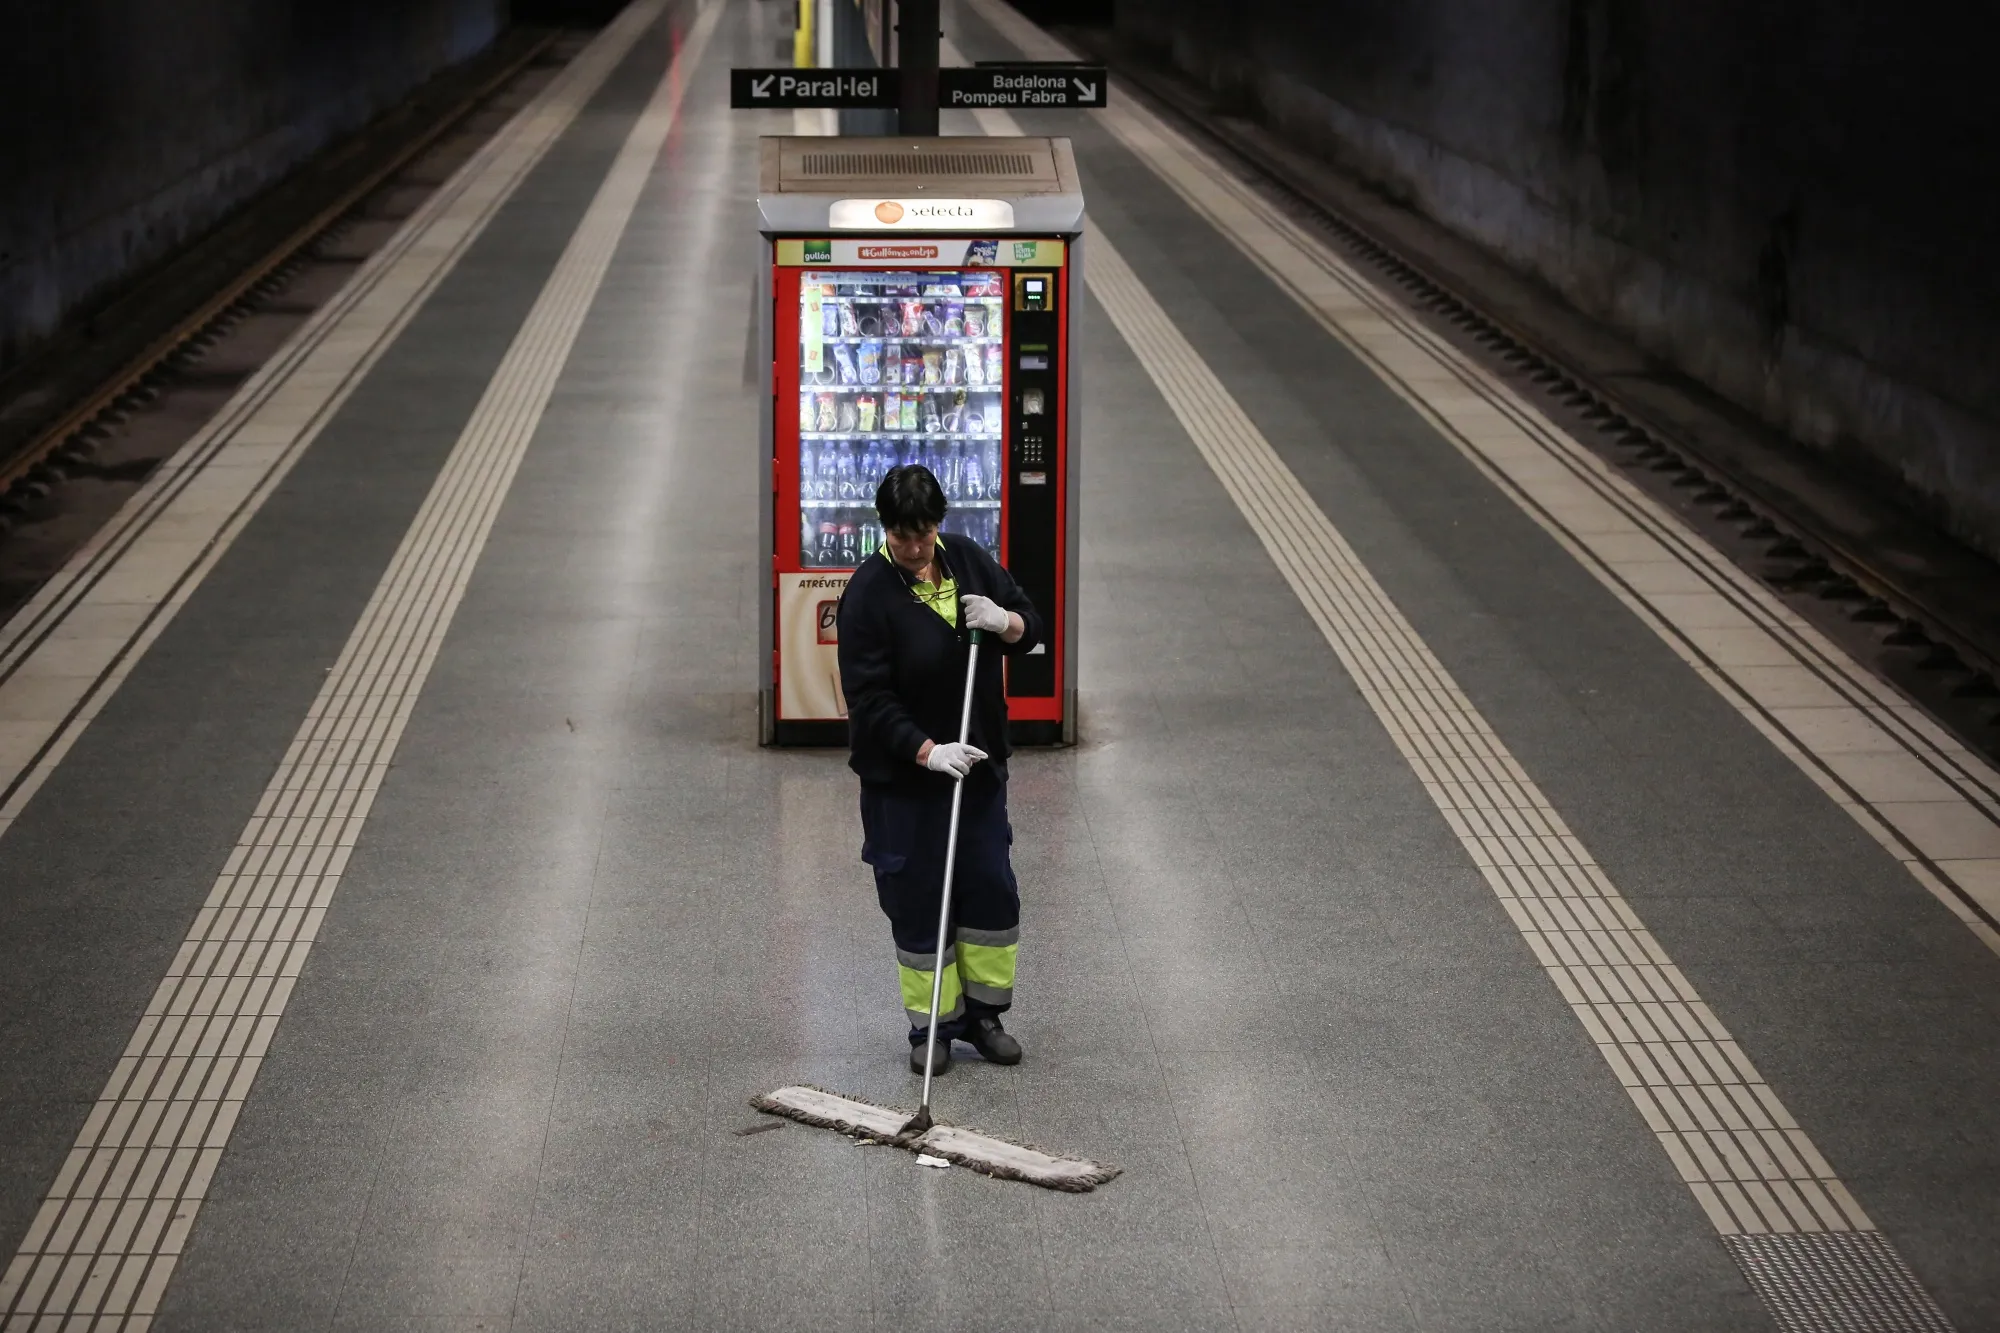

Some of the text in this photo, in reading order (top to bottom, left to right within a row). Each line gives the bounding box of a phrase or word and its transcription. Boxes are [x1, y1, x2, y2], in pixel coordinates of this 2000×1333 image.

[779, 76, 878, 97] Paral·lel
[993, 75, 1067, 89] Badalona
[952, 90, 1067, 106] Pompeu Fabra
[911, 205, 974, 217] selecta
[804, 251, 831, 262] gullón
[799, 576, 848, 588] ATRÉVETE
